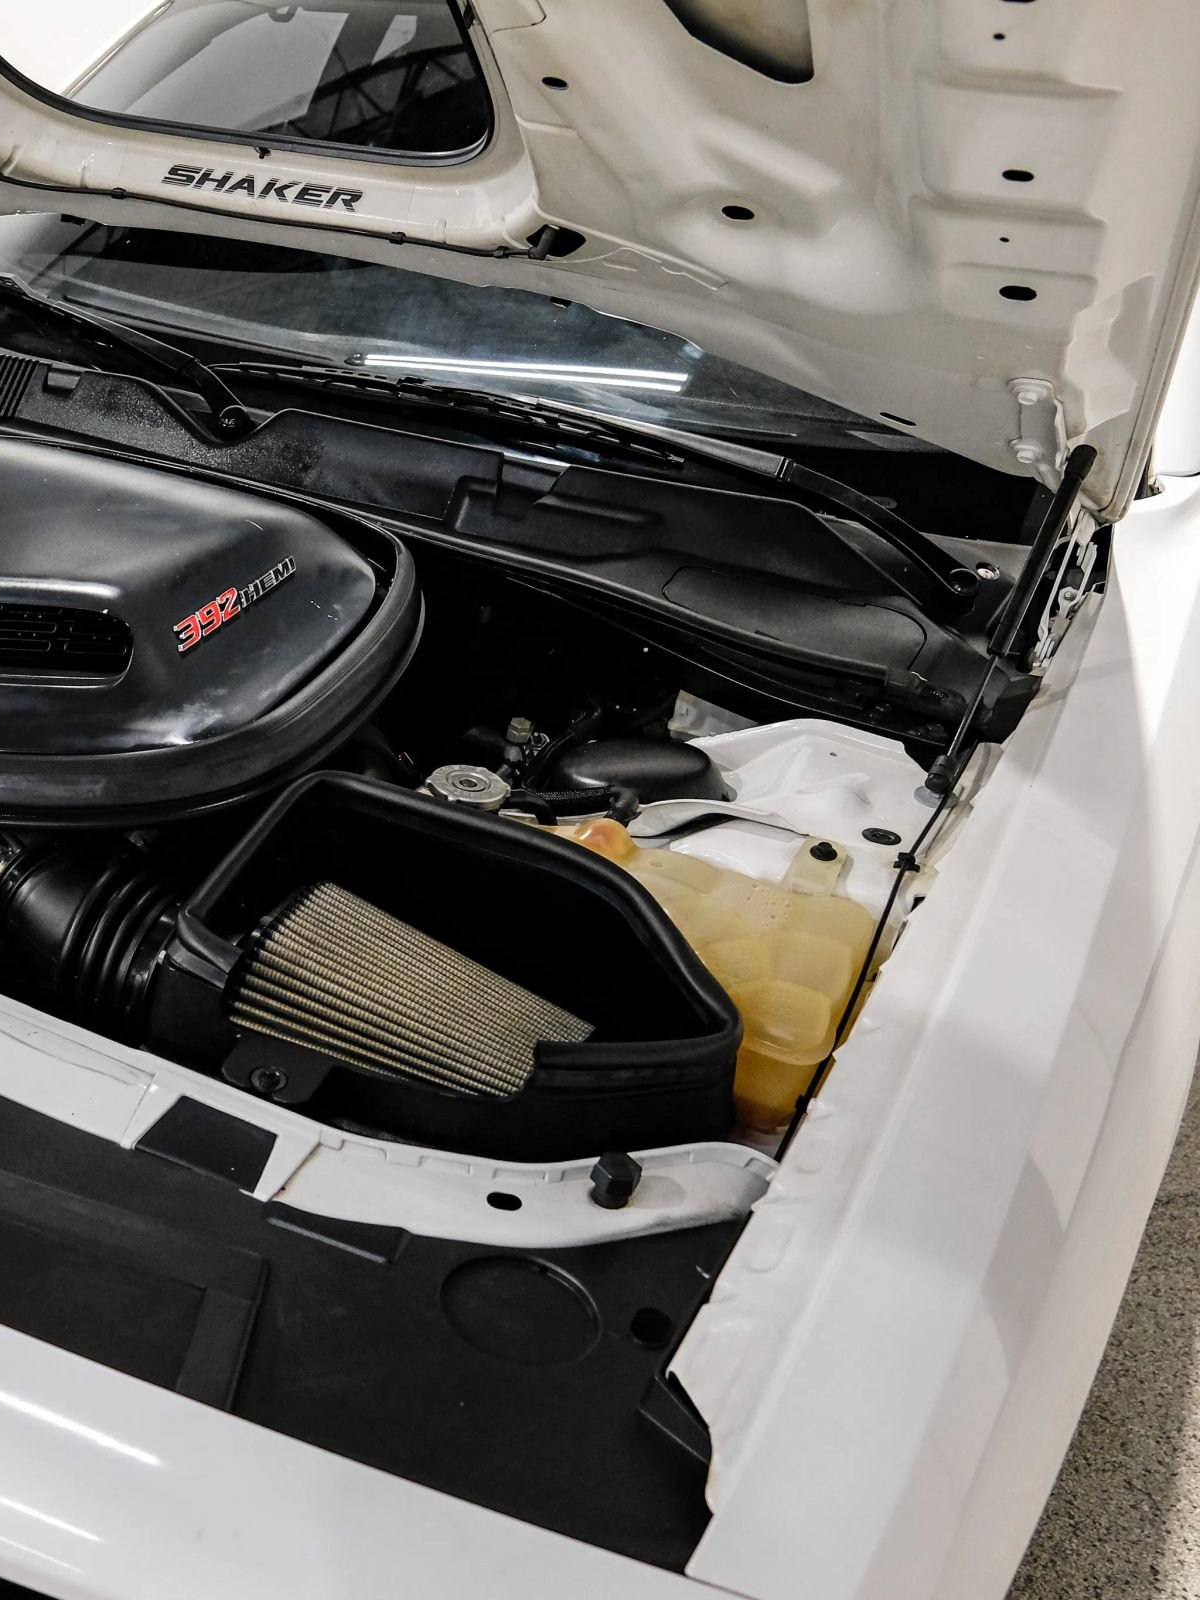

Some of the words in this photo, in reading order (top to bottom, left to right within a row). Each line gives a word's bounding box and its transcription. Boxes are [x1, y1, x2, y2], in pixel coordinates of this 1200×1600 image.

[161, 163, 364, 212] SHAKER
[173, 587, 241, 652] 392
[238, 555, 296, 608] HEMI
